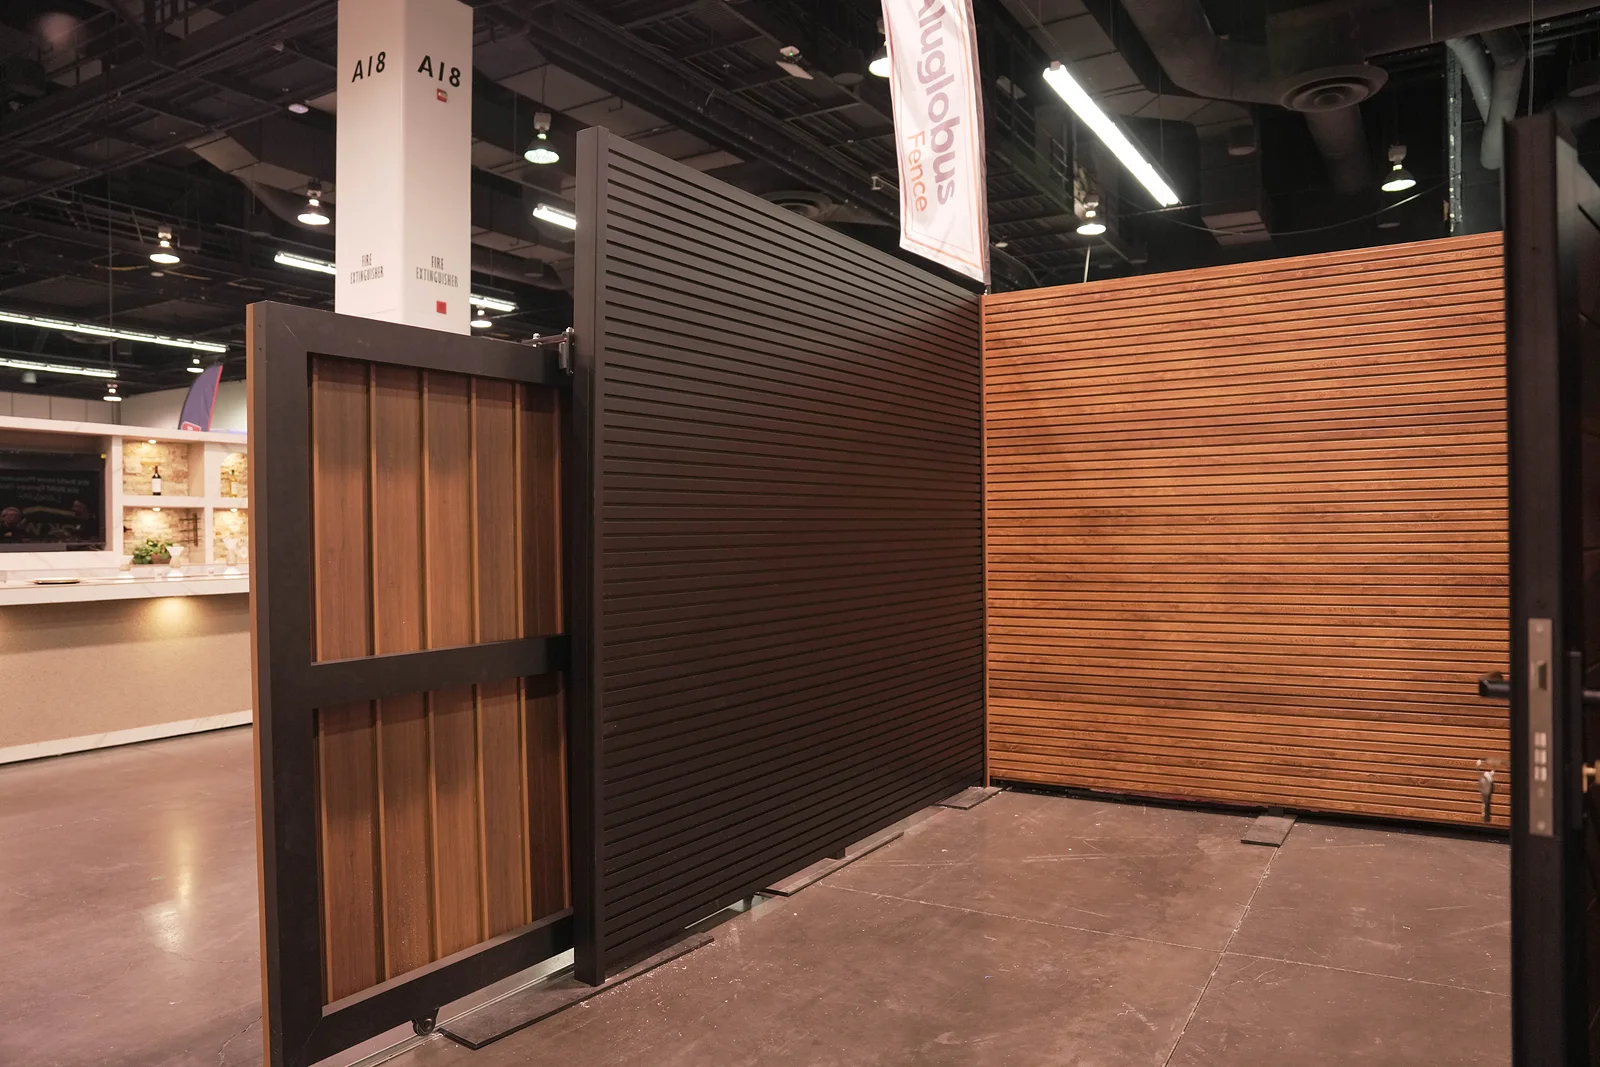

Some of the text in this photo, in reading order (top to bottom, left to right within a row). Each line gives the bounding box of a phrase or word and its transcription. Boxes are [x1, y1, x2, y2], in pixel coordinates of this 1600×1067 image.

[351, 51, 386, 83] A18
[417, 55, 461, 88] A18
[908, 131, 928, 212] Fence
[361, 253, 372, 267] FIRE
[431, 256, 444, 270] FIRE
[350, 266, 384, 284] EXTINGUISHER
[416, 267, 459, 288] EXTINGUISHER
